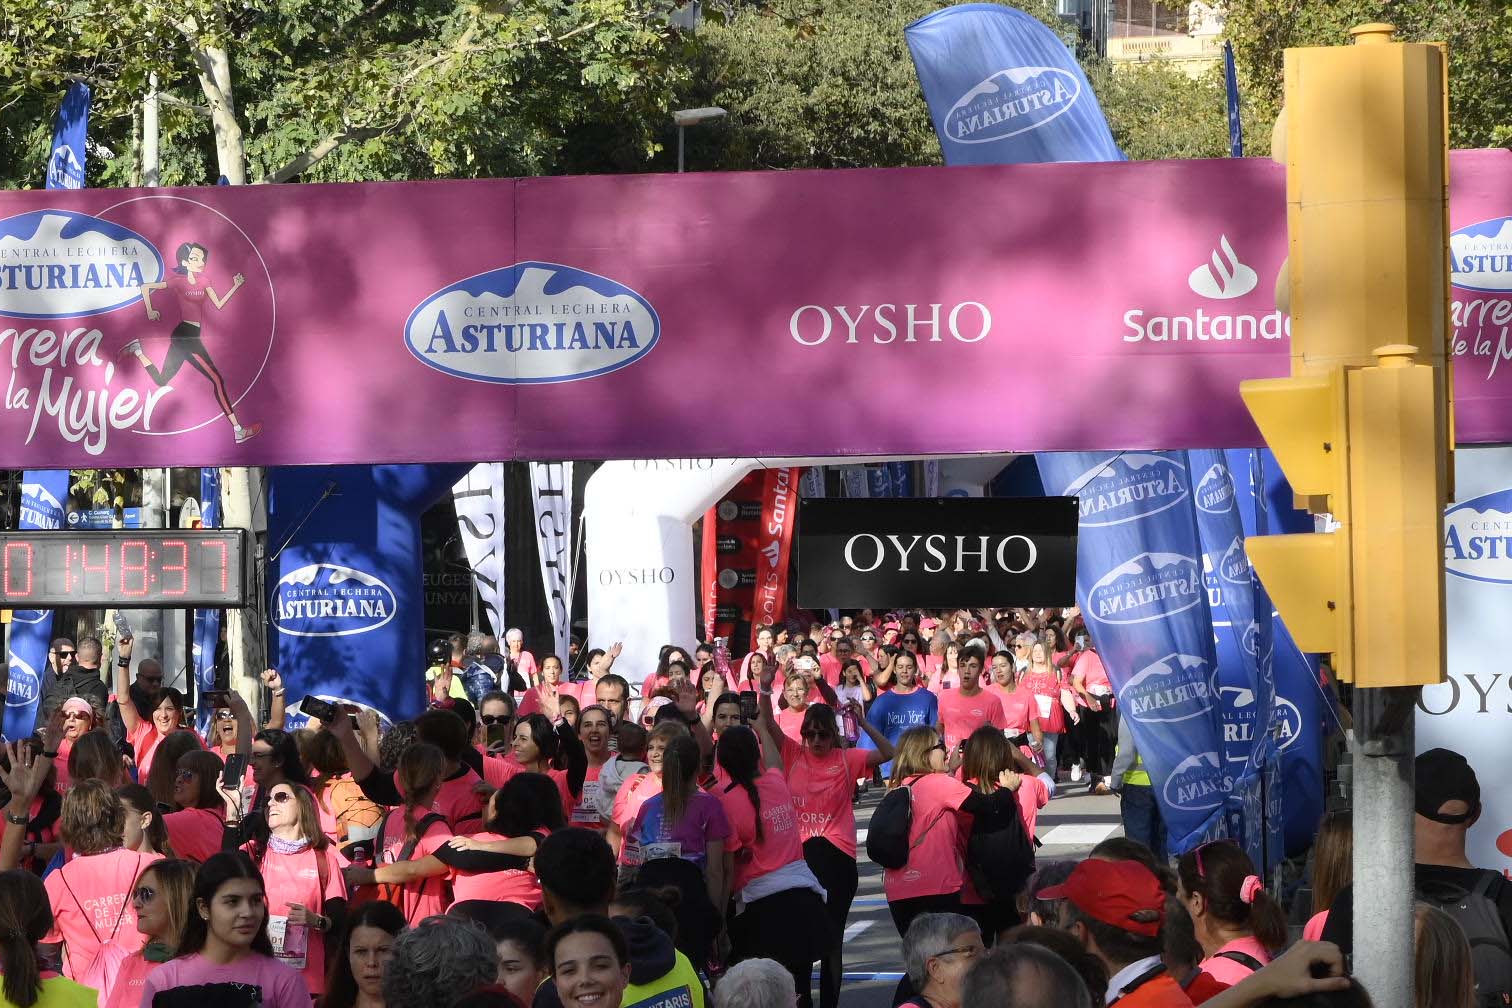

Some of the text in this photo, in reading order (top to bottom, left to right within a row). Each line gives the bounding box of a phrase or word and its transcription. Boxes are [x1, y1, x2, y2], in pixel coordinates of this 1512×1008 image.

[464, 303, 632, 318] CENTRAL LECHERA
[424, 309, 640, 354] ASTURIANA
[789, 302, 993, 346] OYSHO
[5, 370, 29, 410] la
[25, 362, 175, 456] Mujer
[844, 533, 1037, 574] OYSHO
[600, 567, 675, 585] OYSHO
[287, 587, 383, 598] CENTRAL LECHERA
[275, 593, 388, 620] ASTURIANA
[888, 709, 926, 724] New York
[94, 908, 109, 919] DE
